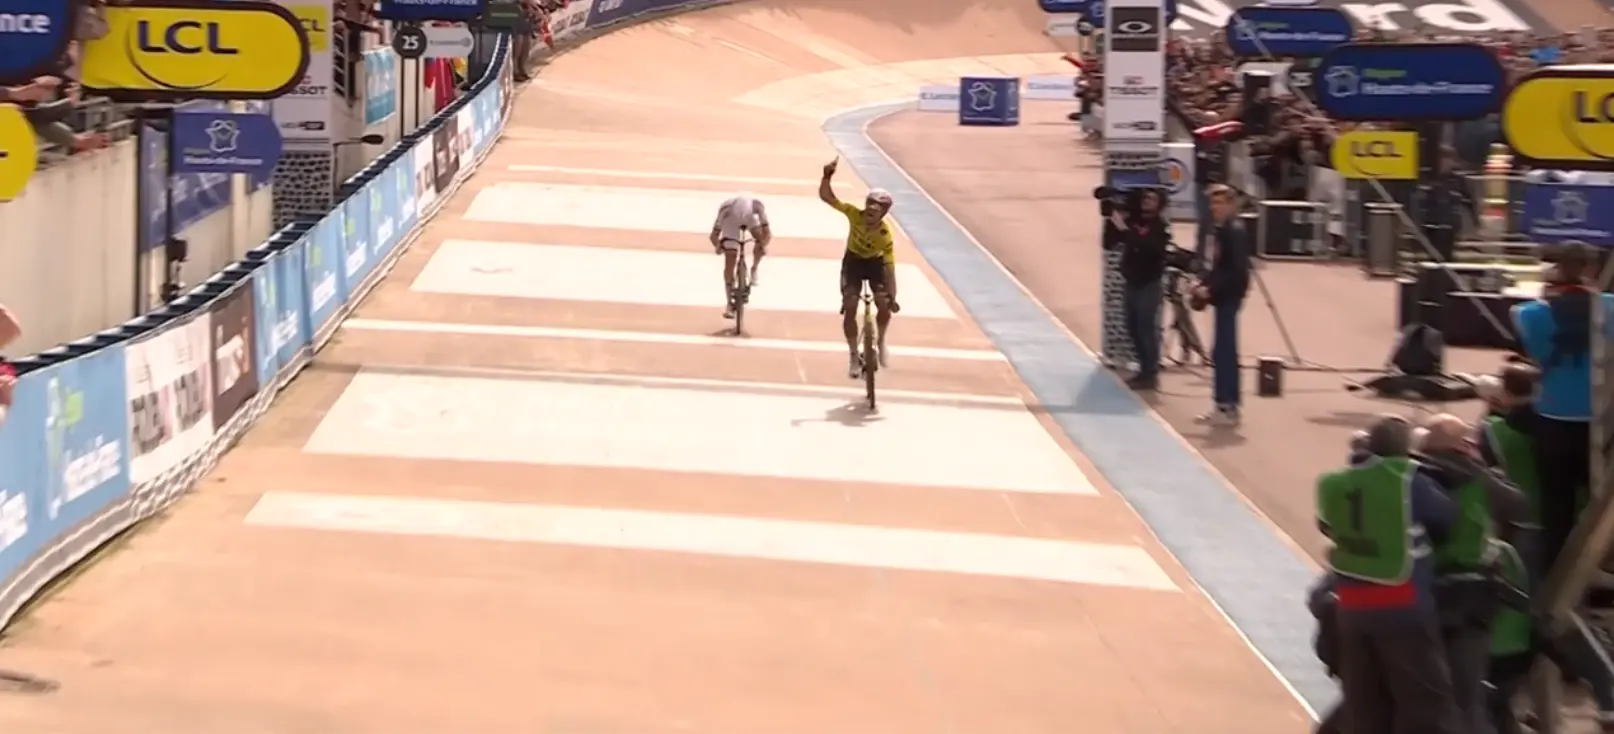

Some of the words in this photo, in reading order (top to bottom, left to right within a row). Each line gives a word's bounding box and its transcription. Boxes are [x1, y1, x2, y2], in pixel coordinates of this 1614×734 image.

[299, 18, 326, 33] CL
[137, 20, 239, 54] LCL
[402, 35, 420, 50] 25
[1350, 140, 1404, 158] LCL
[1345, 487, 1364, 533] 1
